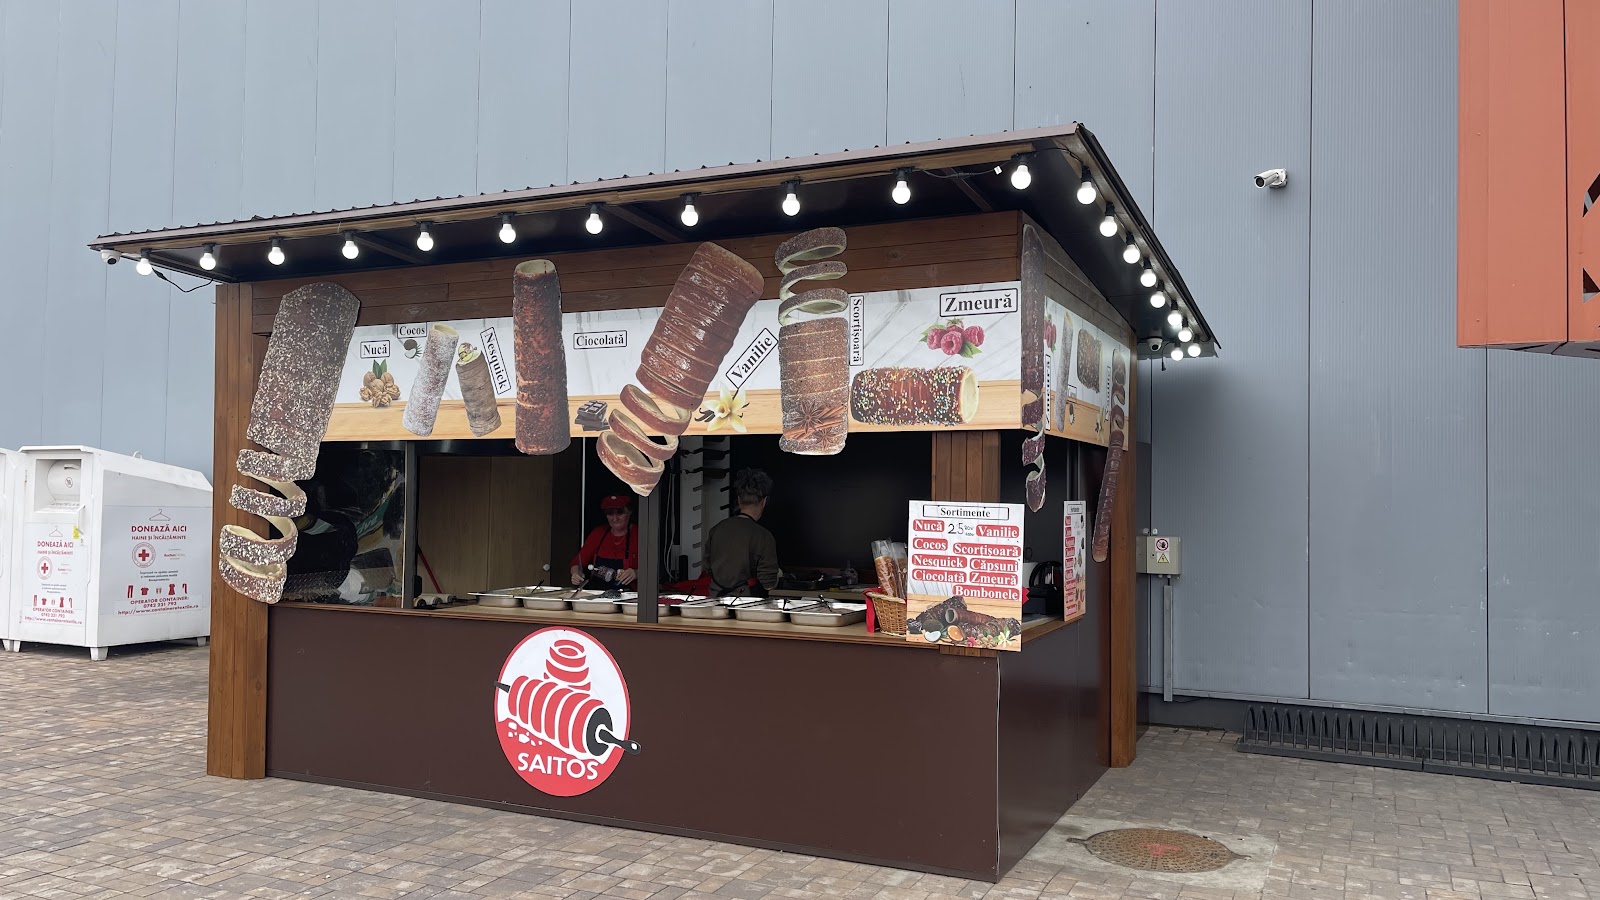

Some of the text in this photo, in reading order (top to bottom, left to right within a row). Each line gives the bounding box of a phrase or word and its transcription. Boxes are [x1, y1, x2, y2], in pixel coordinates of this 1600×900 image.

[944, 294, 1013, 312] Zmeură
[399, 326, 426, 336] Cocos
[576, 334, 624, 347] Ciocolată
[362, 343, 388, 356] Nucă
[484, 331, 507, 392] Nesquick
[730, 335, 773, 381] Vanilie
[940, 507, 991, 518] Sortimente
[131, 524, 170, 532] DONEAZĂ
[914, 520, 943, 532] Nucă
[948, 522, 964, 534] 25
[978, 525, 1018, 538] Vanilie
[914, 538, 947, 551] Cocos
[914, 555, 964, 568] Nesquick
[970, 558, 1018, 572] Căpsuni
[912, 570, 965, 583] Ciocolată
[970, 572, 1018, 586] Zmeură
[955, 585, 1019, 600] Bombonele
[518, 752, 599, 780] SAITOS
